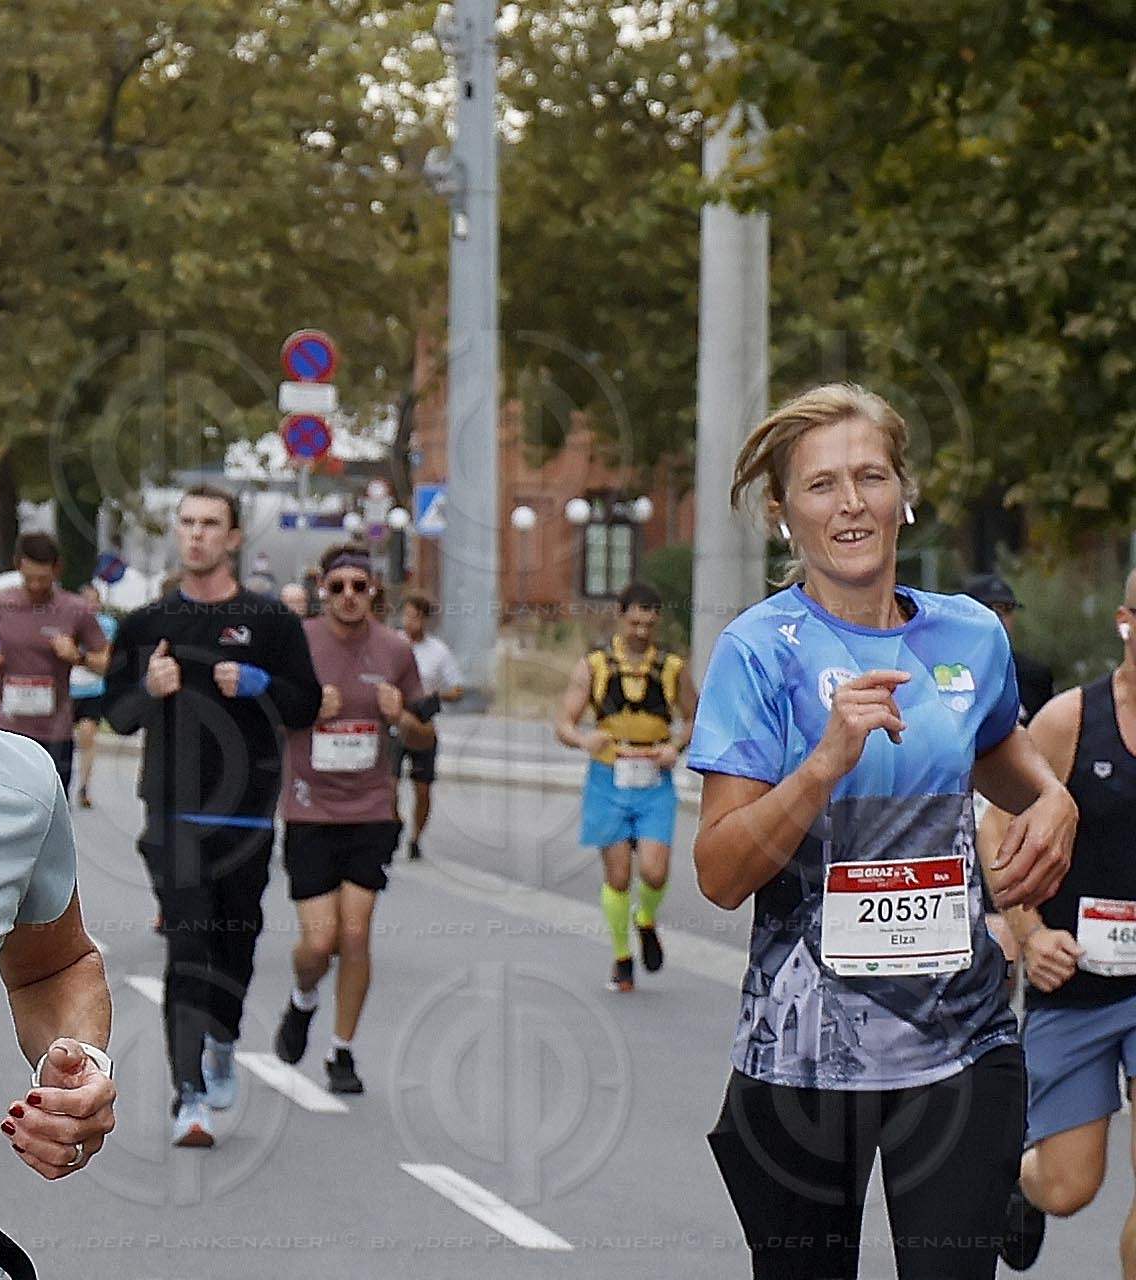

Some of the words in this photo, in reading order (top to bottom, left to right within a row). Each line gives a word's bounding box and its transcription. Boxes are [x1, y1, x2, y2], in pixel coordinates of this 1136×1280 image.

[864, 867, 894, 877] GRAZ
[858, 894, 942, 923] 20537
[891, 935, 915, 945] Elza
